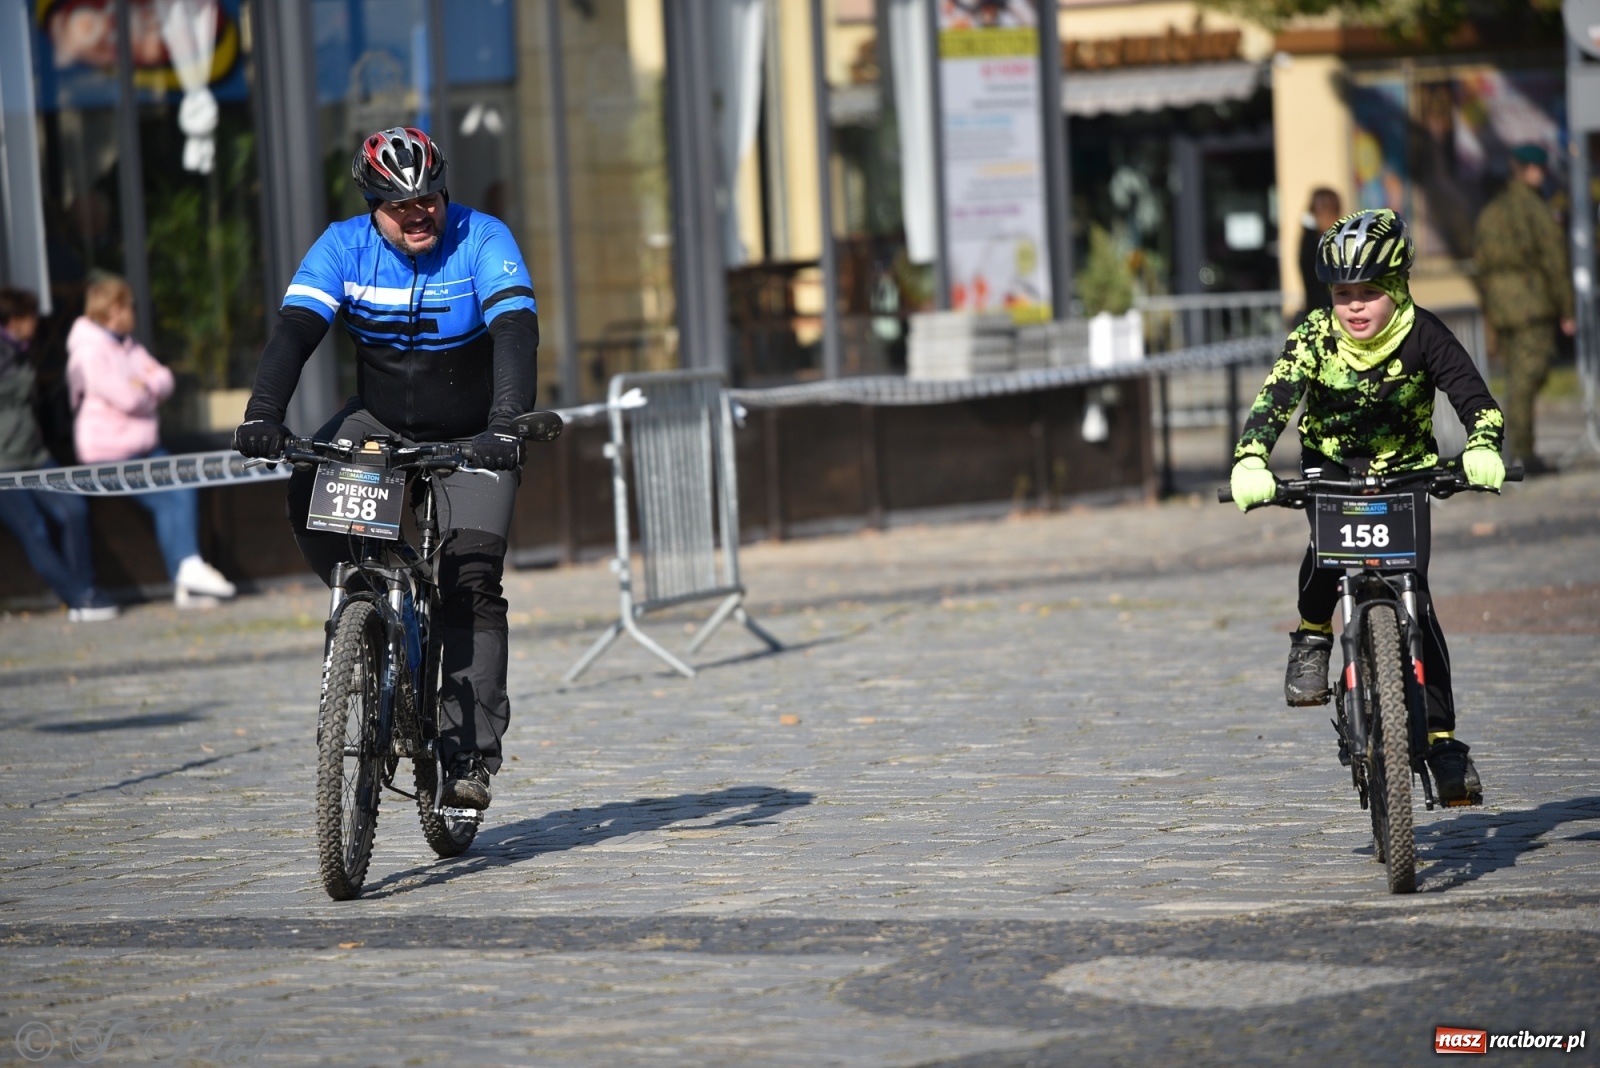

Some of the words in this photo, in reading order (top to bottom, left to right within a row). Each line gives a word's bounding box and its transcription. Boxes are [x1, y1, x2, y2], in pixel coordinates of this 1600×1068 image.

[326, 482, 389, 500] OPIEKUN
[331, 495, 377, 521] 158
[1339, 523, 1390, 548] 158
